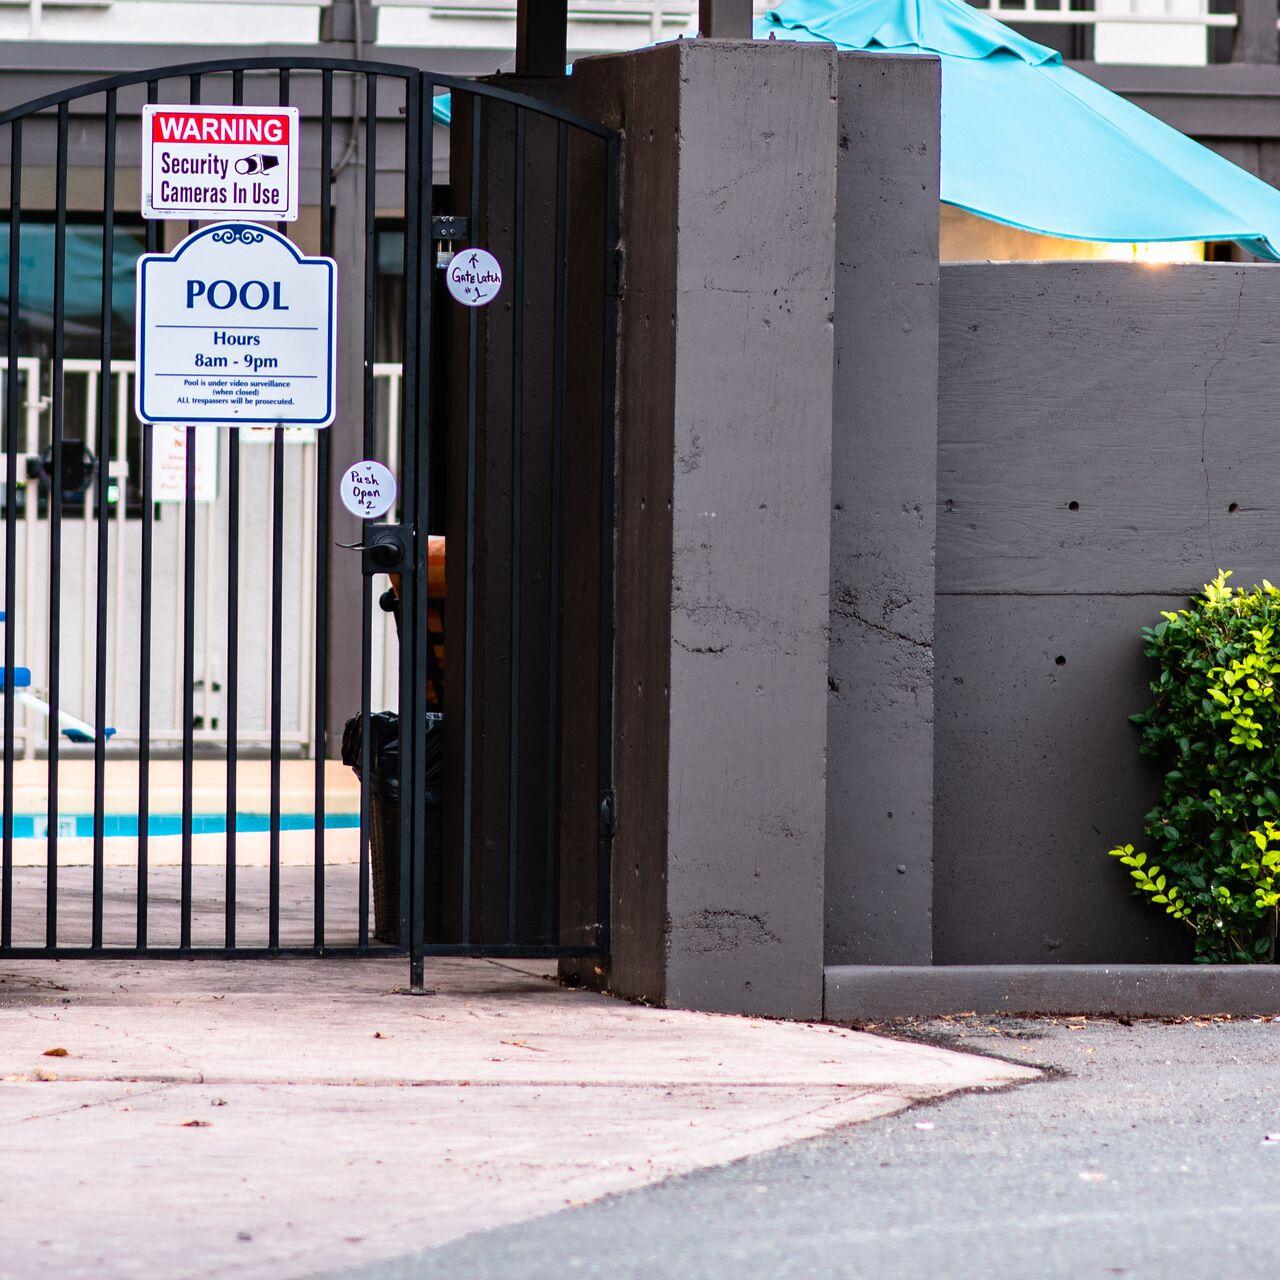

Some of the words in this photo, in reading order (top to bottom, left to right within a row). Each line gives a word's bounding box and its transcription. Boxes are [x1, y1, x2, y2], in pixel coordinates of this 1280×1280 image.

[160, 117, 283, 142] WARNING
[161, 151, 229, 180] Security
[161, 180, 227, 203] Cameras
[233, 182, 247, 204] In
[252, 182, 280, 204] Use
[186, 280, 289, 311] POOL
[213, 331, 261, 346] Hours
[194, 353, 228, 367] 8am
[243, 354, 278, 372] 9pm
[250, 380, 291, 388] surveillance
[192, 397, 229, 406] trespassers
[230, 397, 243, 405] will
[255, 398, 295, 406] prosecuted.
[351, 471, 379, 485] Push
[353, 486, 380, 501] Open
